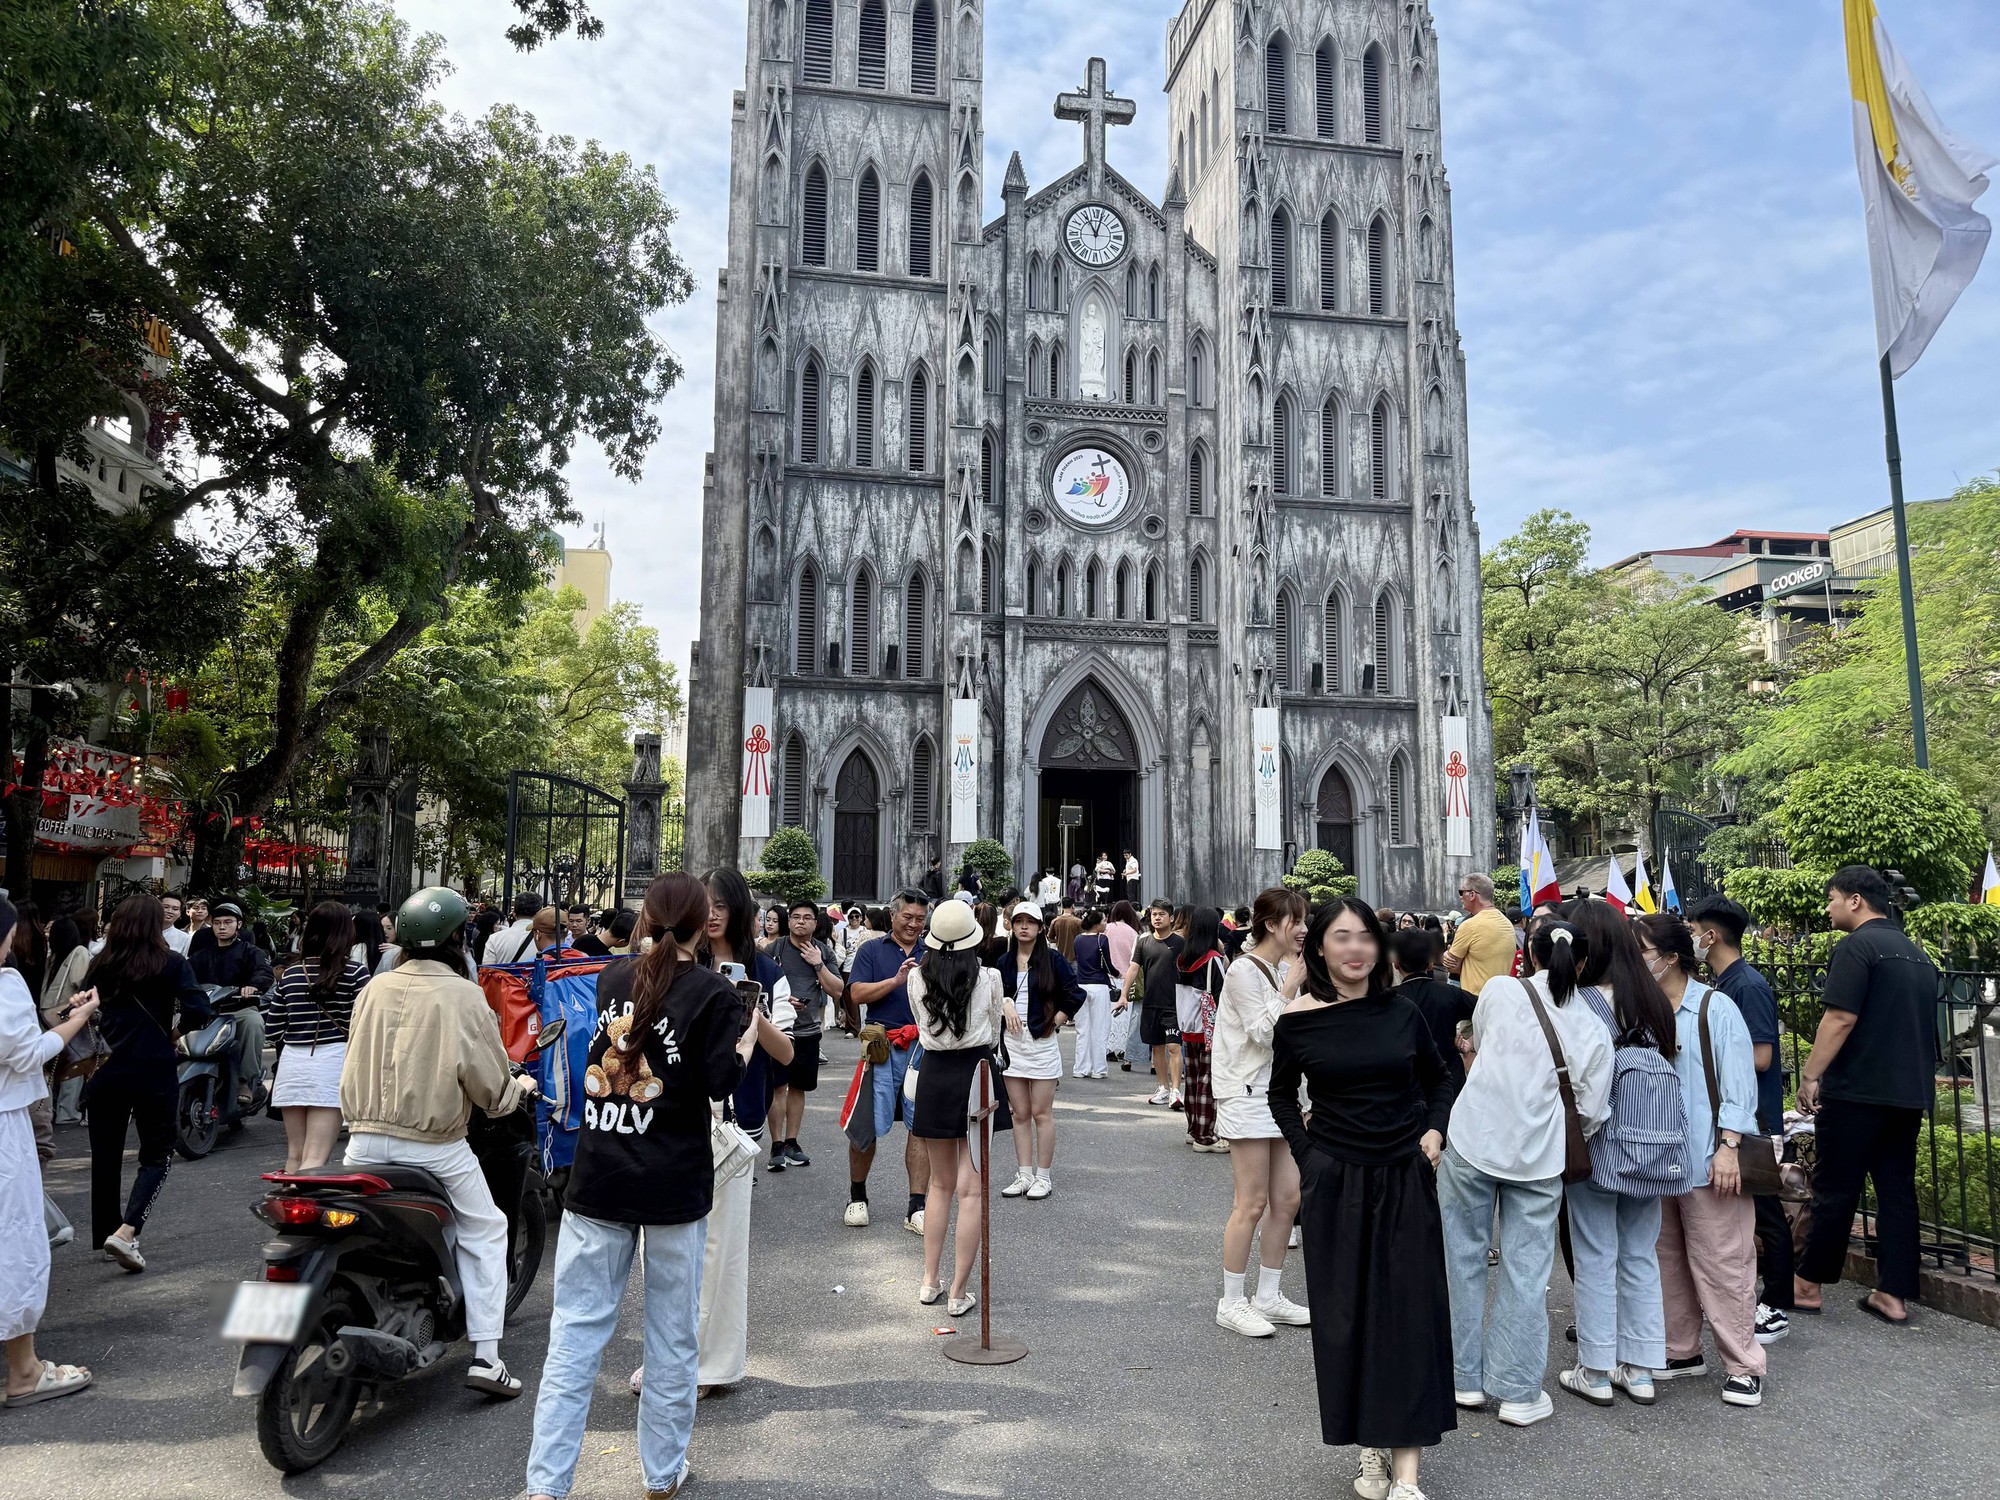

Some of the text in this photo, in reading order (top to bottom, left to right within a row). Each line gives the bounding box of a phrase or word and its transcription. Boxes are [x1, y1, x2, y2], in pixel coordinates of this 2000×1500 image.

[39, 818, 69, 834] COFFEE
[94, 827, 117, 840] TAPAS
[663, 1029, 681, 1064] VIE
[1165, 1028, 1180, 1037] NIKE
[584, 1099, 654, 1135] ADLV
